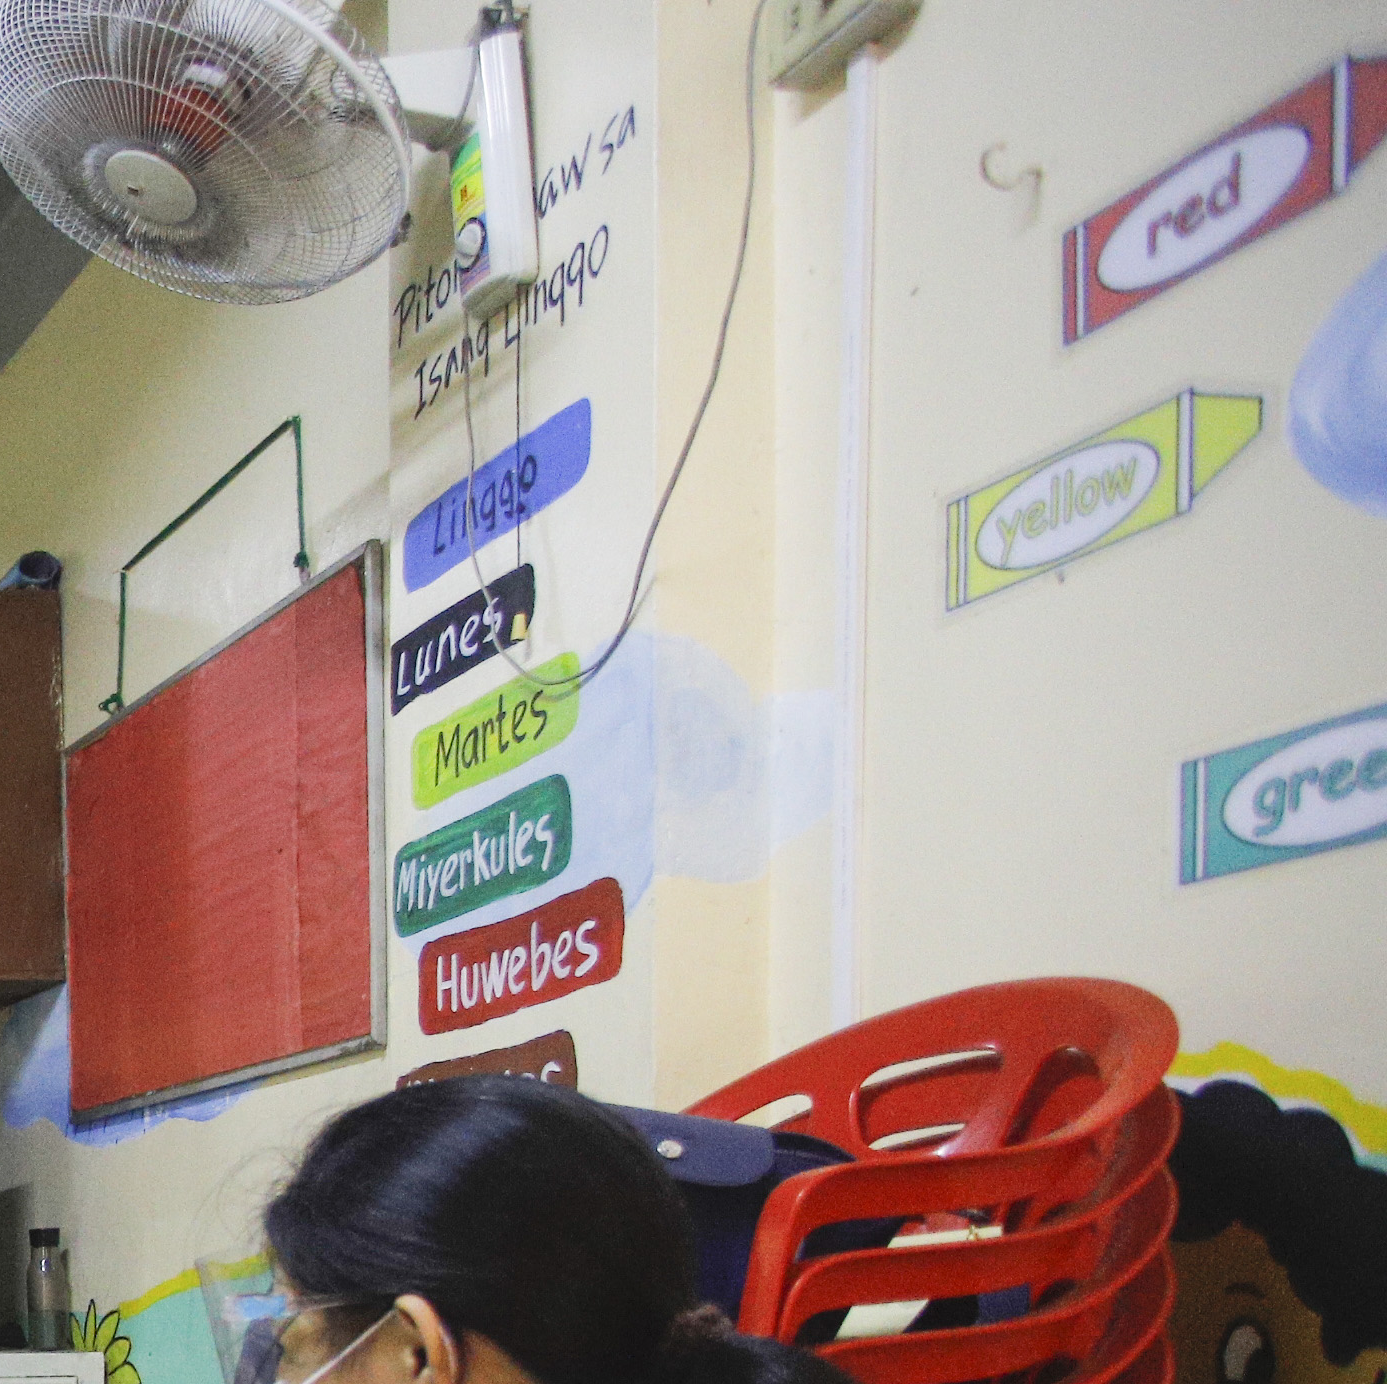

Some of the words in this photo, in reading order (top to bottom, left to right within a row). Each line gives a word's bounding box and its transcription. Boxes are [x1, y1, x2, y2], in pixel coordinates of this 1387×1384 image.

[598, 103, 636, 176] sa
[1146, 152, 1243, 260] red
[414, 316, 491, 421] Isang
[432, 453, 538, 558] Linggo
[994, 455, 1140, 568] yellow
[396, 597, 503, 696] Lunes
[435, 689, 548, 788] Martes
[396, 809, 556, 914] Miyerkules
[435, 919, 600, 1013] Huwebes
